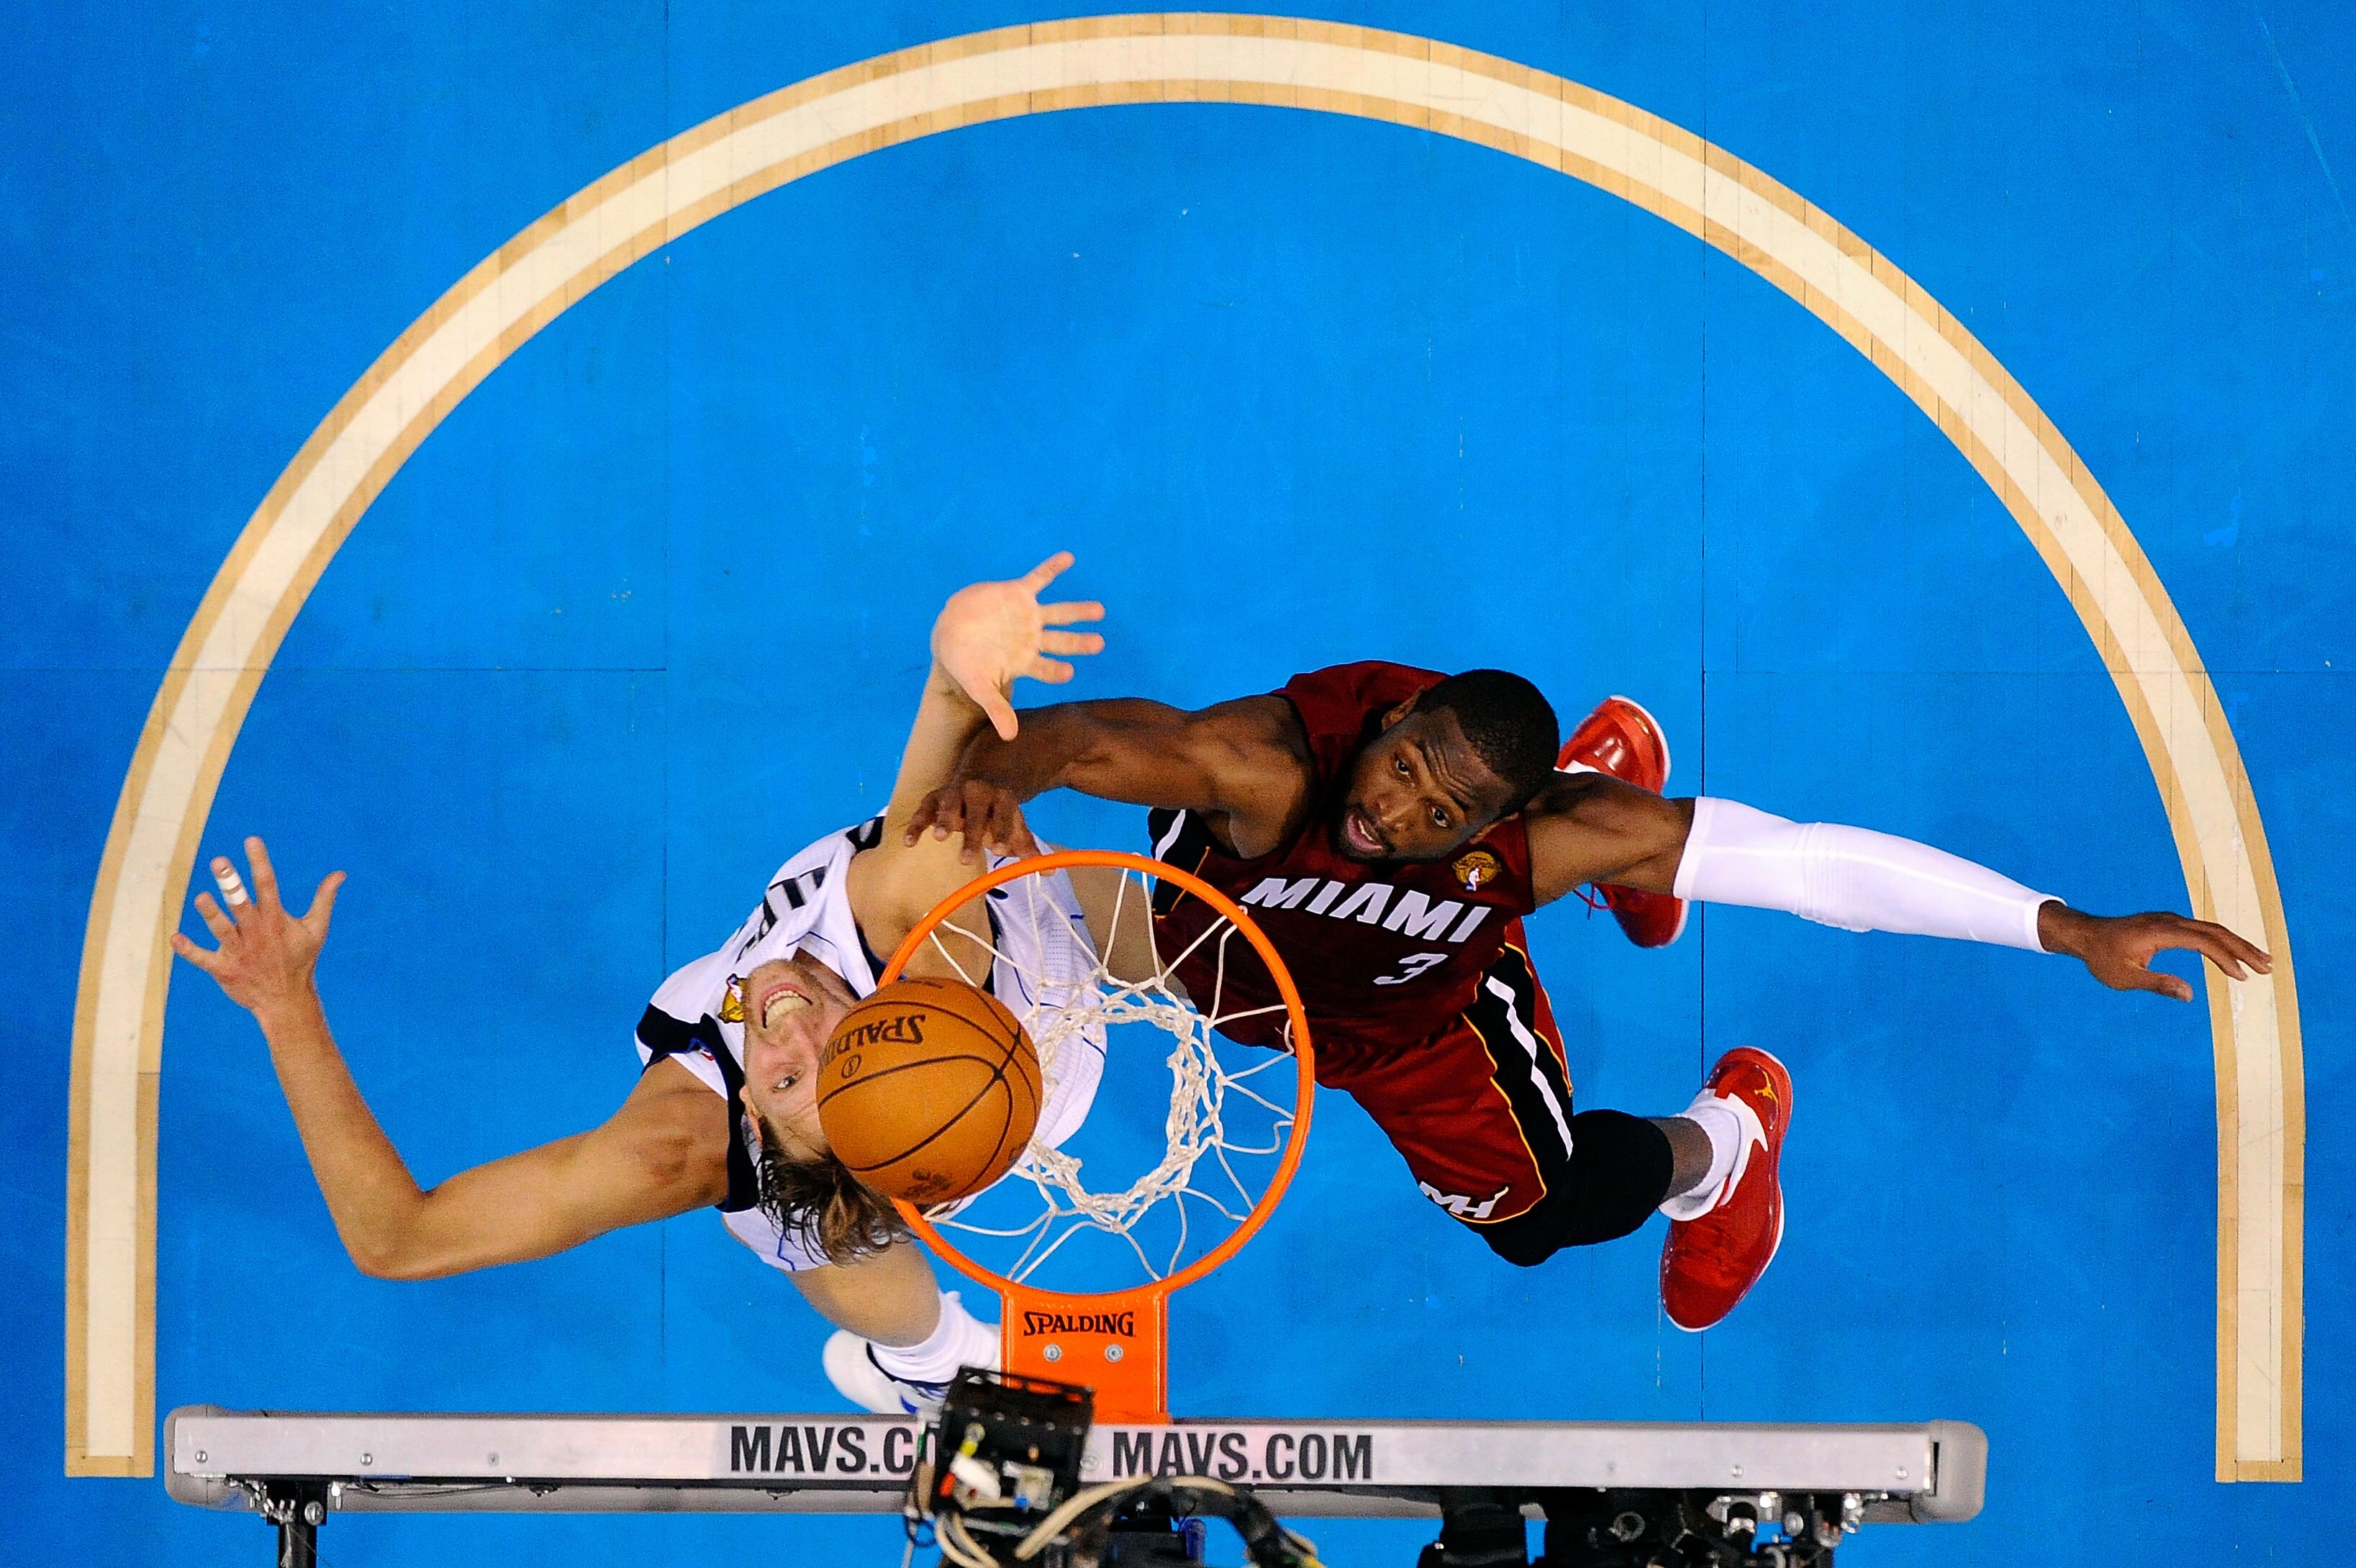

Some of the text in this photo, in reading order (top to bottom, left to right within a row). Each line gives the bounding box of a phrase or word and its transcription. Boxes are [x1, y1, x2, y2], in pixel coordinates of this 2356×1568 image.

[1241, 877, 1492, 943] MIAMI
[1372, 952, 1449, 986] 3
[823, 1014, 927, 1066] SPALDI
[1023, 1310, 1134, 1338] SPALDING
[730, 1426, 938, 1474] MAVS.C
[1113, 1431, 1373, 1480] MAVS.COM
